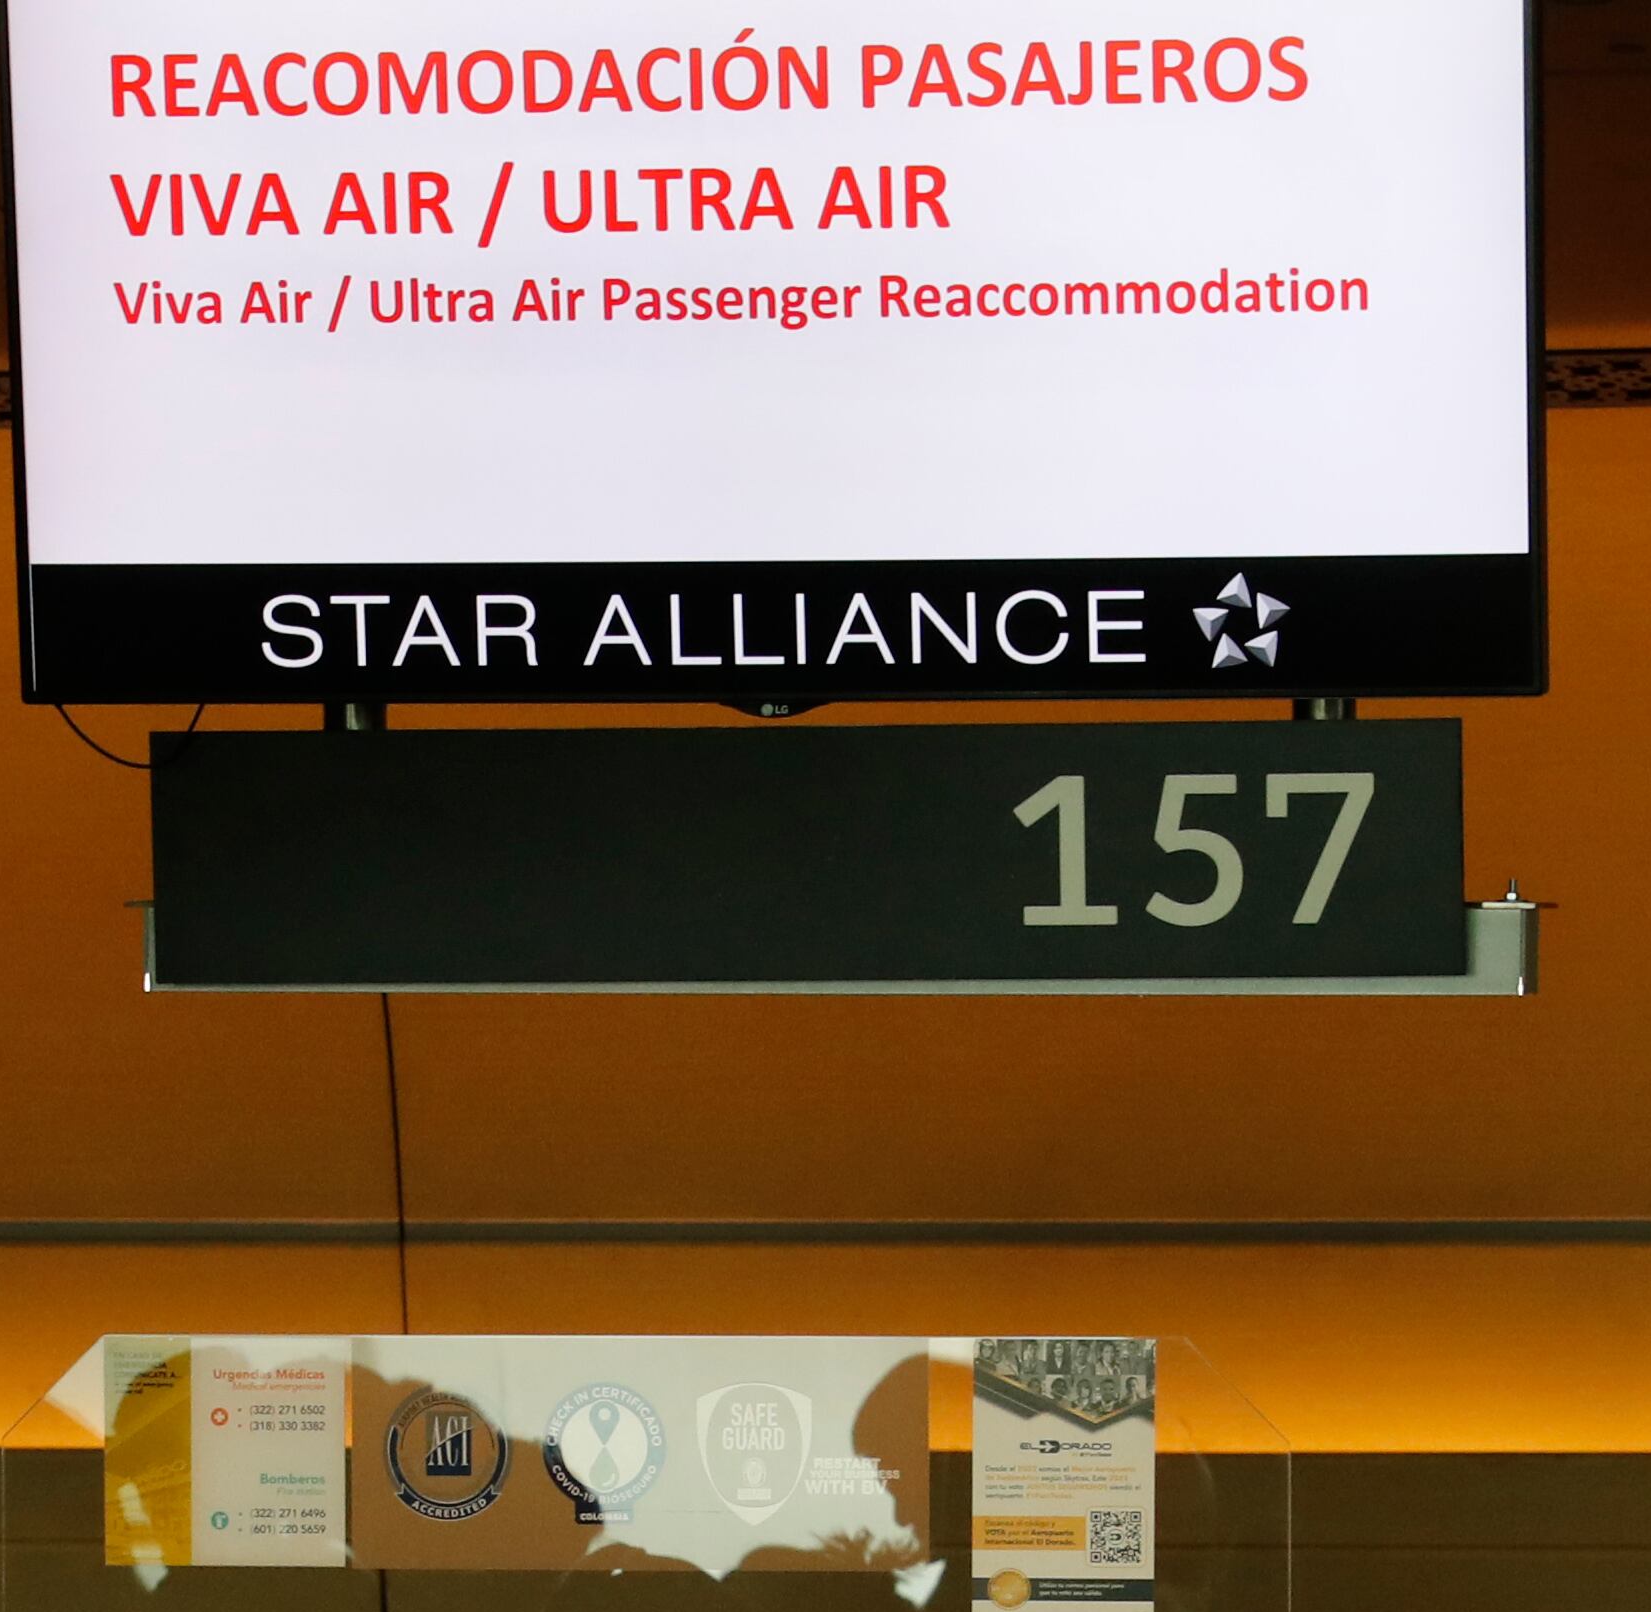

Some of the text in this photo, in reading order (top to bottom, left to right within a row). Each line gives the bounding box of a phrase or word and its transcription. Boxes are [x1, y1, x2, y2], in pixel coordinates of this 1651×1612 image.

[110, 27, 1309, 118] REACOMODACIÓN PASAJEROS
[110, 161, 951, 249] VIVA AIR / ULTRA AIR
[113, 267, 1369, 333] Viva Air / Ultra Air Passenger Reaccommodation
[261, 589, 1147, 668] STAR ALLIANCE
[774, 704, 789, 714] LG
[1013, 772, 1376, 927] 157
[213, 1368, 325, 1381] Urgencias Médicas
[250, 1405, 325, 1416] (322) 271 6502
[547, 1386, 663, 1447] CHECK IN CERTIFICADO
[731, 1402, 778, 1427] SAFE
[278, 1421, 297, 1431] 330
[428, 1415, 469, 1467] ACI
[721, 1427, 785, 1450] GUARD
[813, 1457, 882, 1469] RESTART
[259, 1472, 325, 1485] Bomberos
[552, 1464, 657, 1505] COVID-19 BIOSEGURO
[804, 1480, 855, 1495] WITH
[250, 1508, 326, 1519] (322) 271 6496
[411, 1498, 487, 1519] ACCREDITED
[250, 1524, 326, 1534] (601) 220 5659
